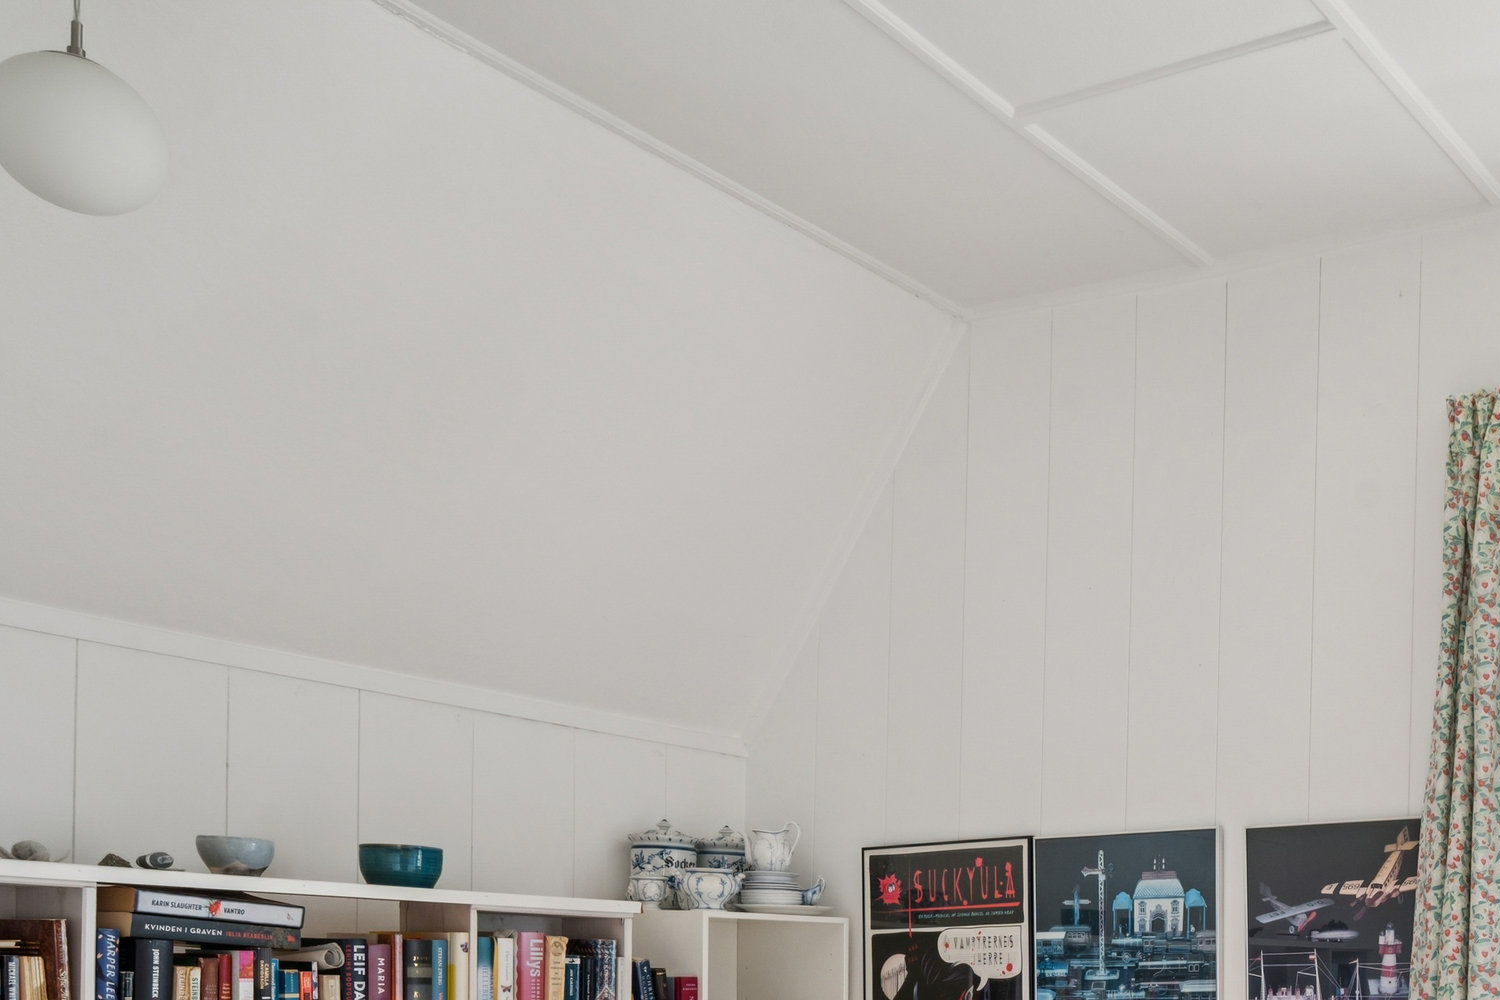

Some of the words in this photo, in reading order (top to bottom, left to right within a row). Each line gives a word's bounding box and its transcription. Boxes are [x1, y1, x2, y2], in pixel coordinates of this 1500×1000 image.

[913, 862, 1016, 903] SUCKYULA
[152, 899, 169, 907] KARIN
[170, 901, 202, 911] SLAUGHTER
[224, 906, 245, 915] VANTRO
[144, 924, 181, 933] KVINDEN
[190, 928, 222, 936] GRAVEN
[106, 934, 116, 977] HARPER
[354, 945, 365, 975] LEIF
[527, 939, 543, 977] Lillys
[8, 962, 16, 984] MICHAEL
[106, 981, 116, 1000] LEE
